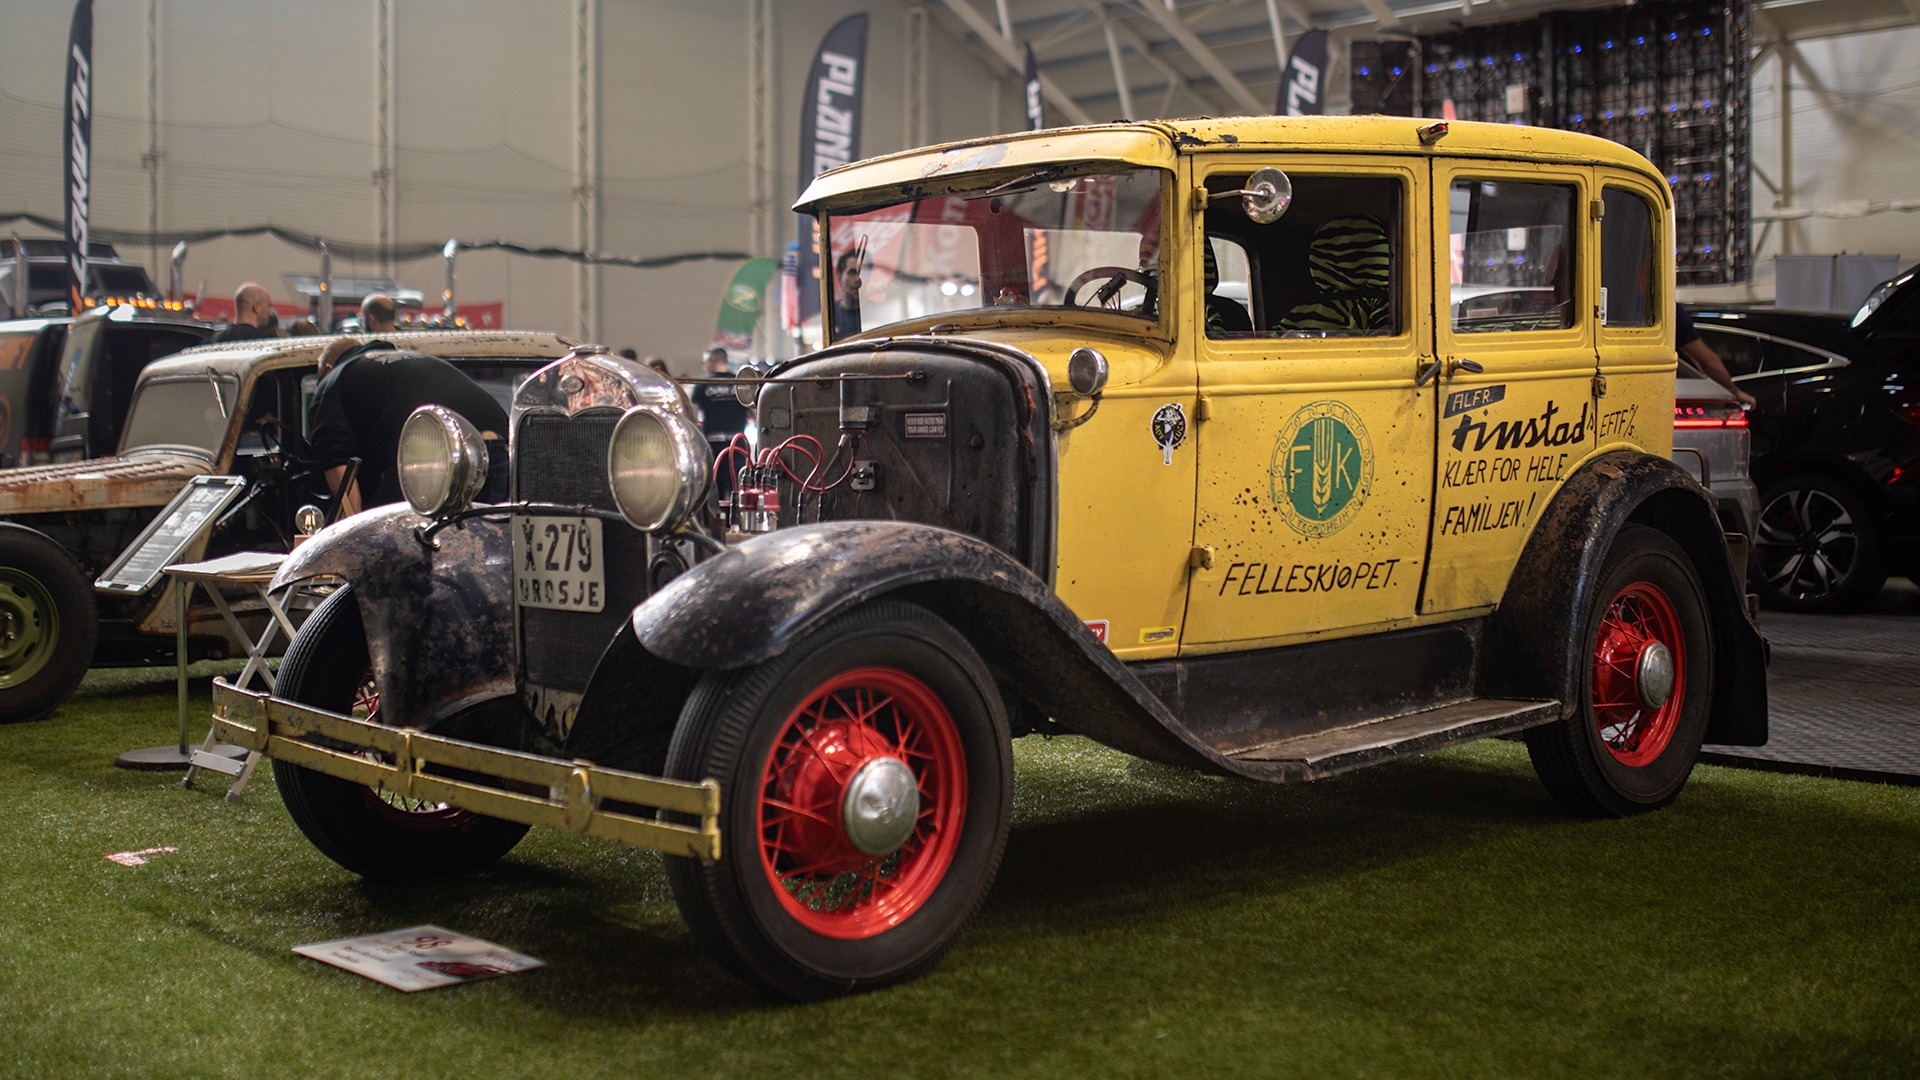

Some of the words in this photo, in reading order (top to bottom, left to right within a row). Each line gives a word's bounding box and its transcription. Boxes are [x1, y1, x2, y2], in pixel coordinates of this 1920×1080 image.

[71, 43, 90, 297] PLANET
[1674, 407, 1704, 415] RES
[1442, 459, 1487, 489] KLÆR
[1490, 457, 1521, 483] FOR
[1526, 453, 1568, 482] HELE
[519, 578, 600, 607] DROSJE
